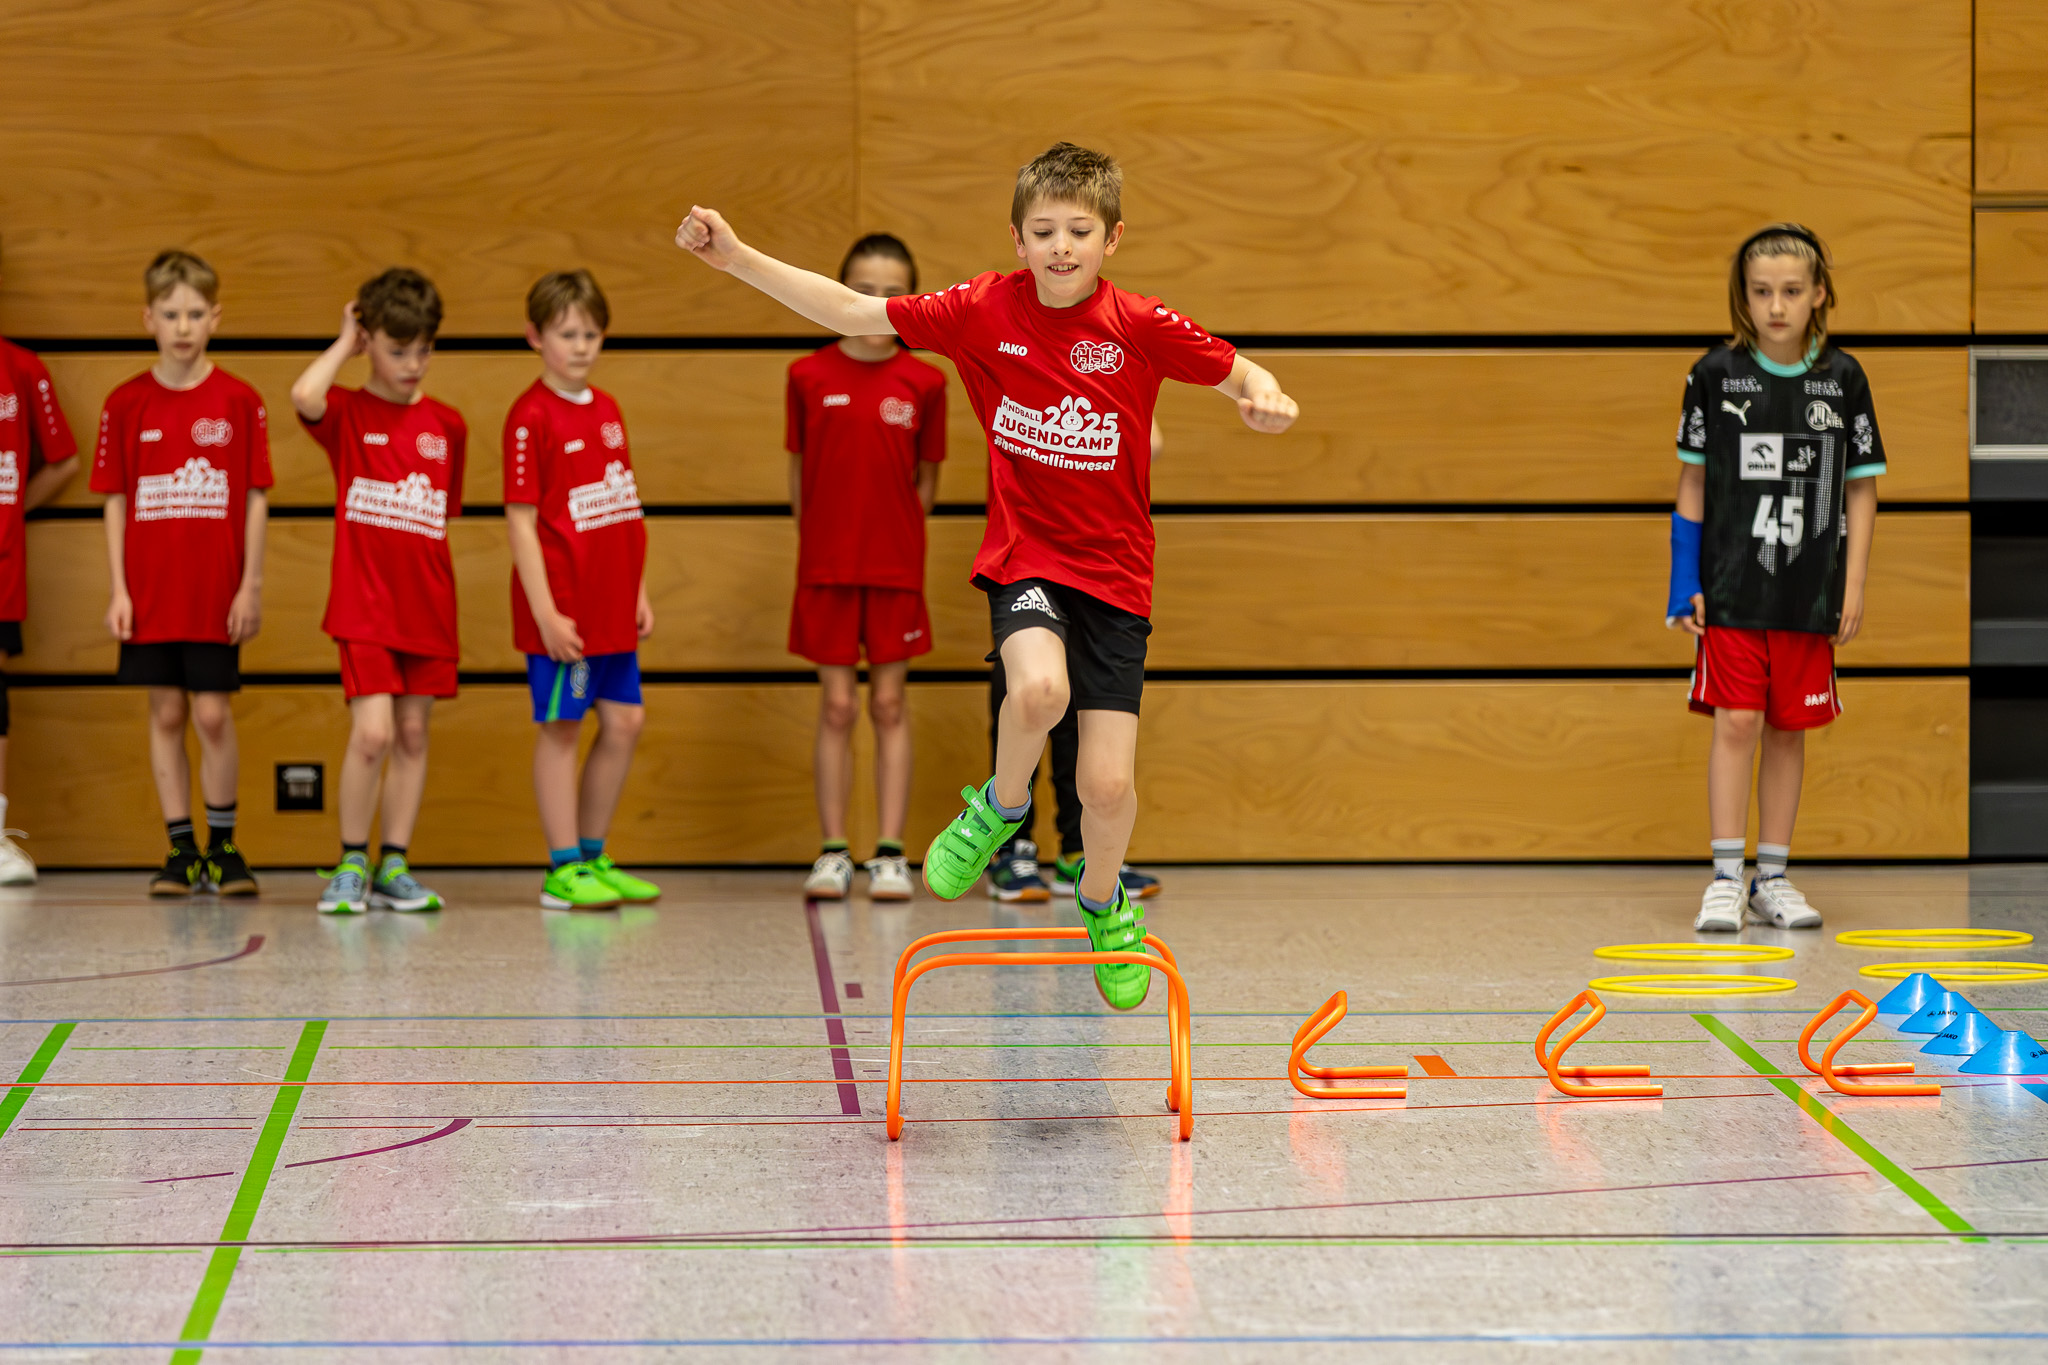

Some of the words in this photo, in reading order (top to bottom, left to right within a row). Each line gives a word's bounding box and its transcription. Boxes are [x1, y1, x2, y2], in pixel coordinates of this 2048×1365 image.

[998, 341, 1028, 356] JAKO
[1078, 347, 1117, 364] HSG
[1003, 400, 1040, 422] HNDBALL
[999, 414, 1114, 450] JUGENDCAMP
[994, 434, 1116, 471] #handballinwesel
[1752, 495, 1804, 547] 45
